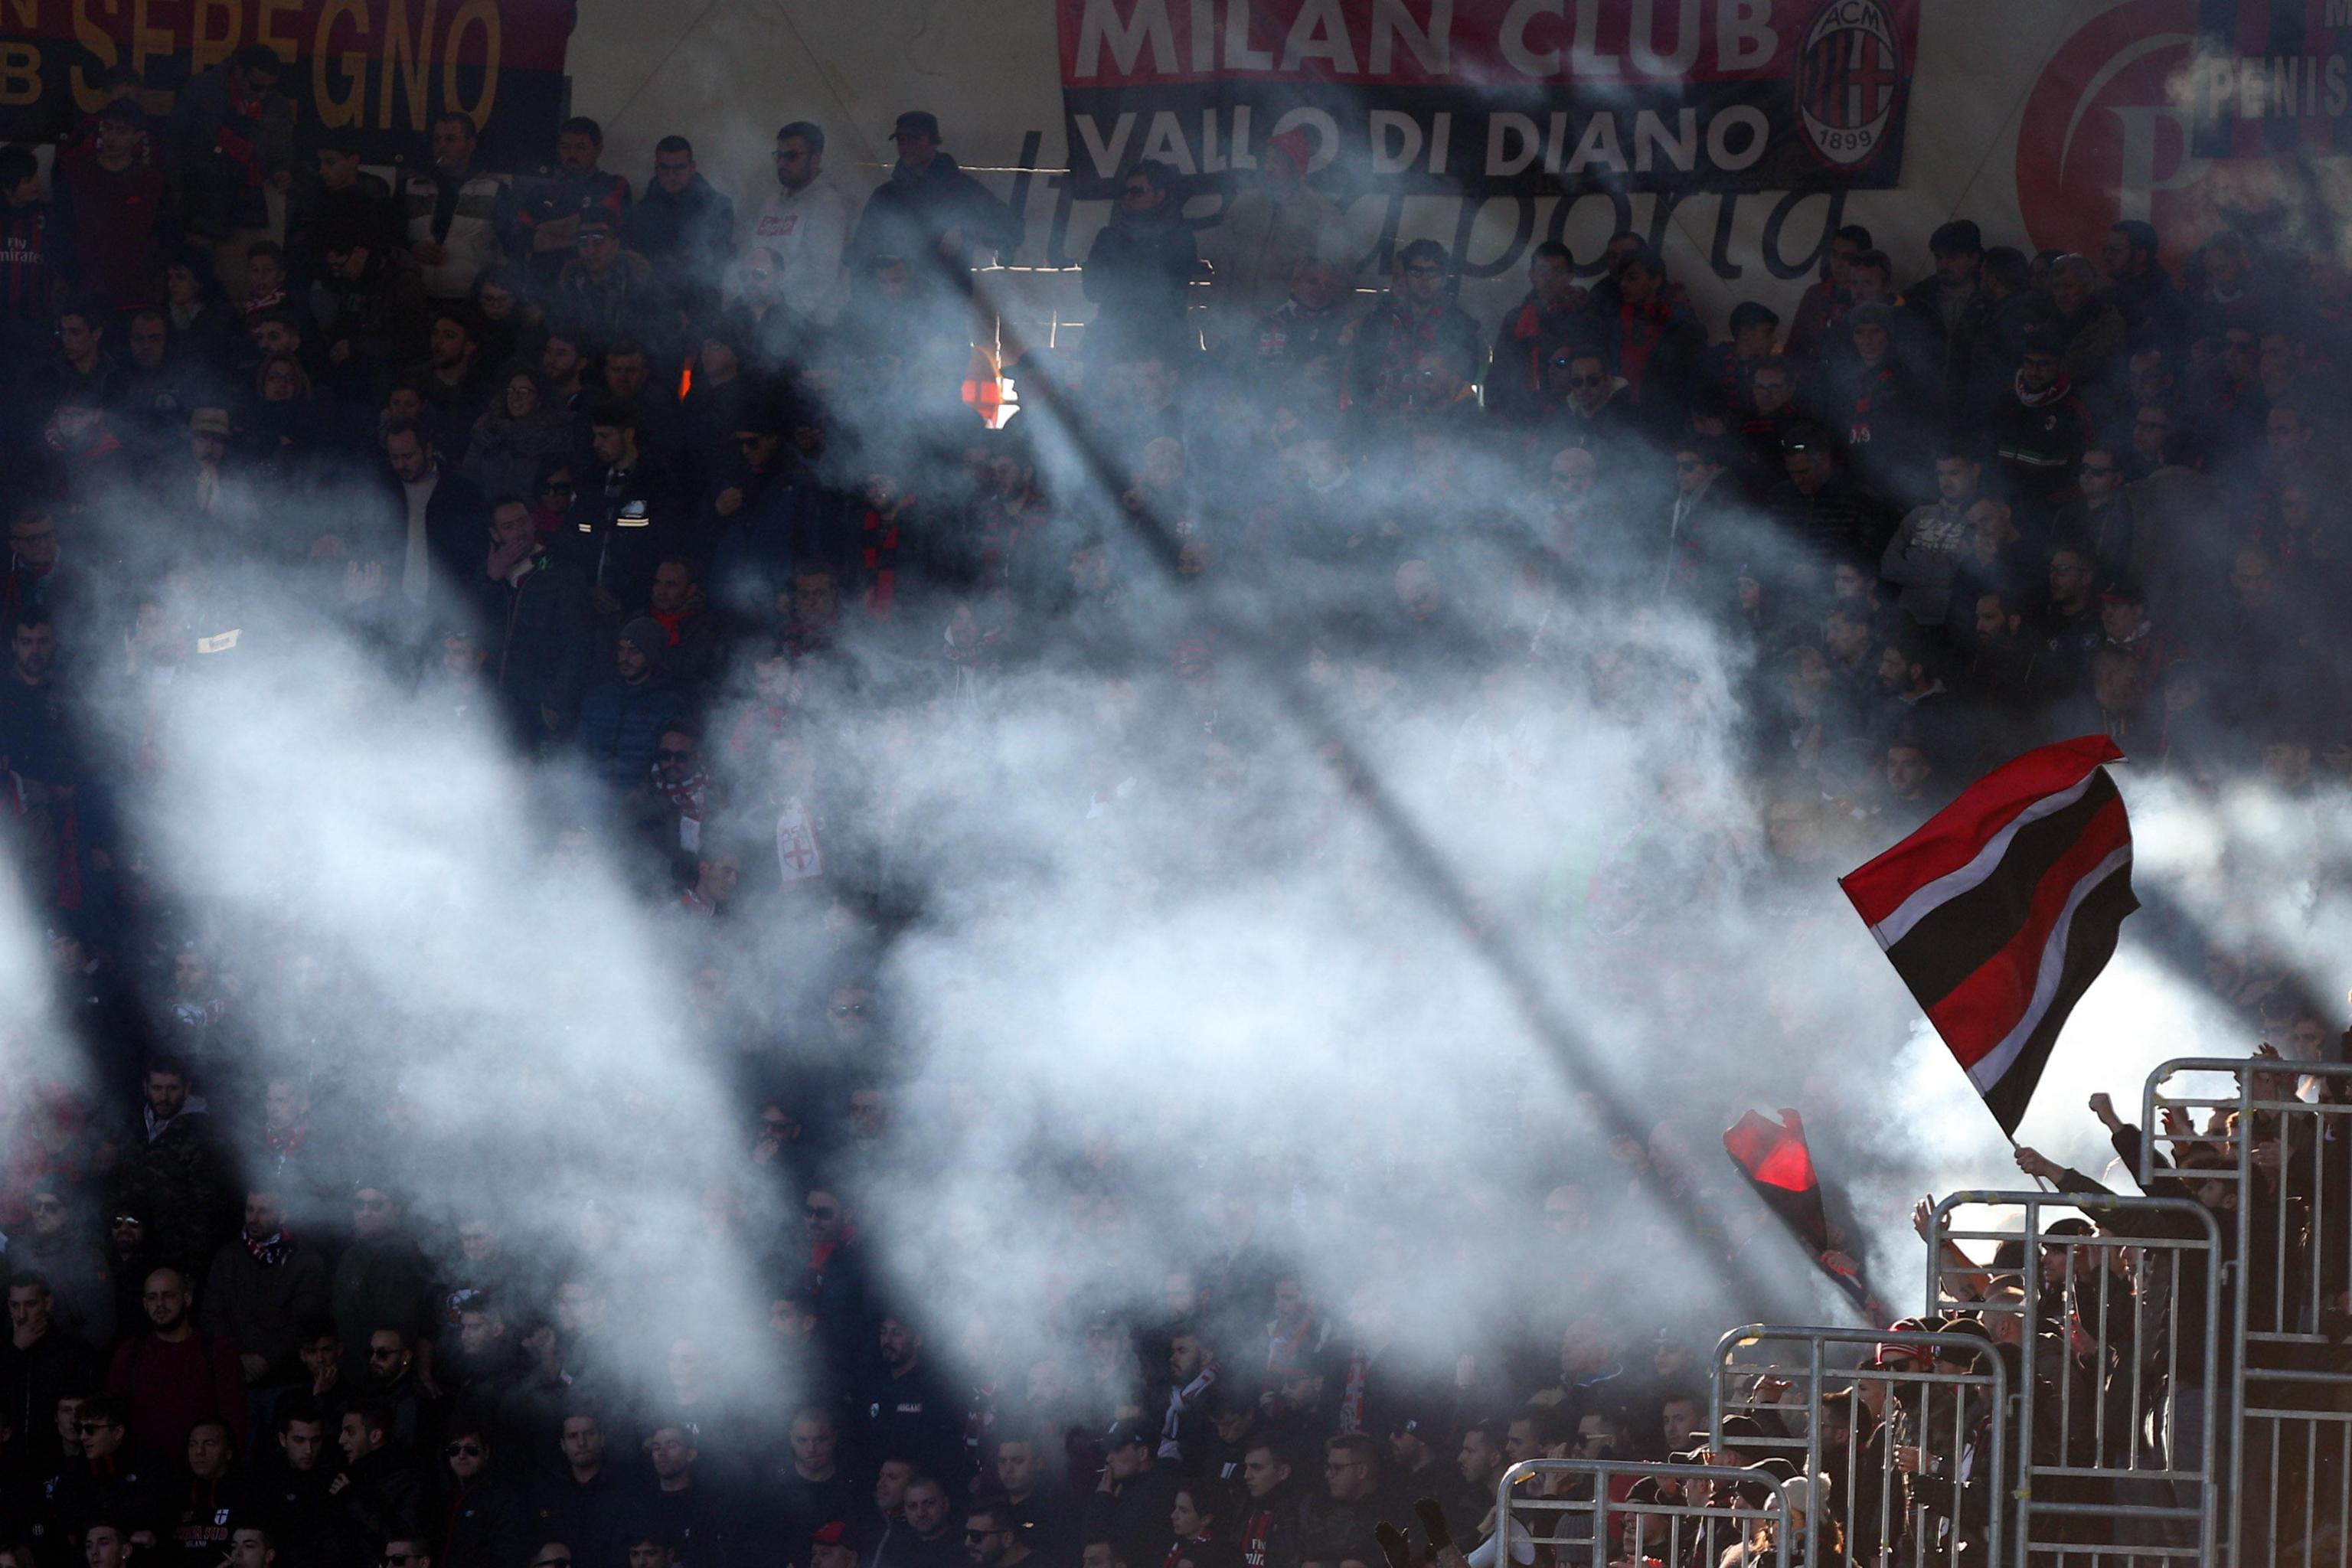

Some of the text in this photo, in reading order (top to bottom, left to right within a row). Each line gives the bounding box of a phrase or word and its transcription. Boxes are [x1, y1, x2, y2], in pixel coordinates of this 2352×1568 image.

[1074, 0, 1779, 77] MILAN CLUB
[1820, 1, 1880, 33] ACM
[2208, 54, 2348, 119] PENIS
[1074, 105, 1769, 178] VALLO DI DIANO
[1819, 129, 1872, 151] 1899
